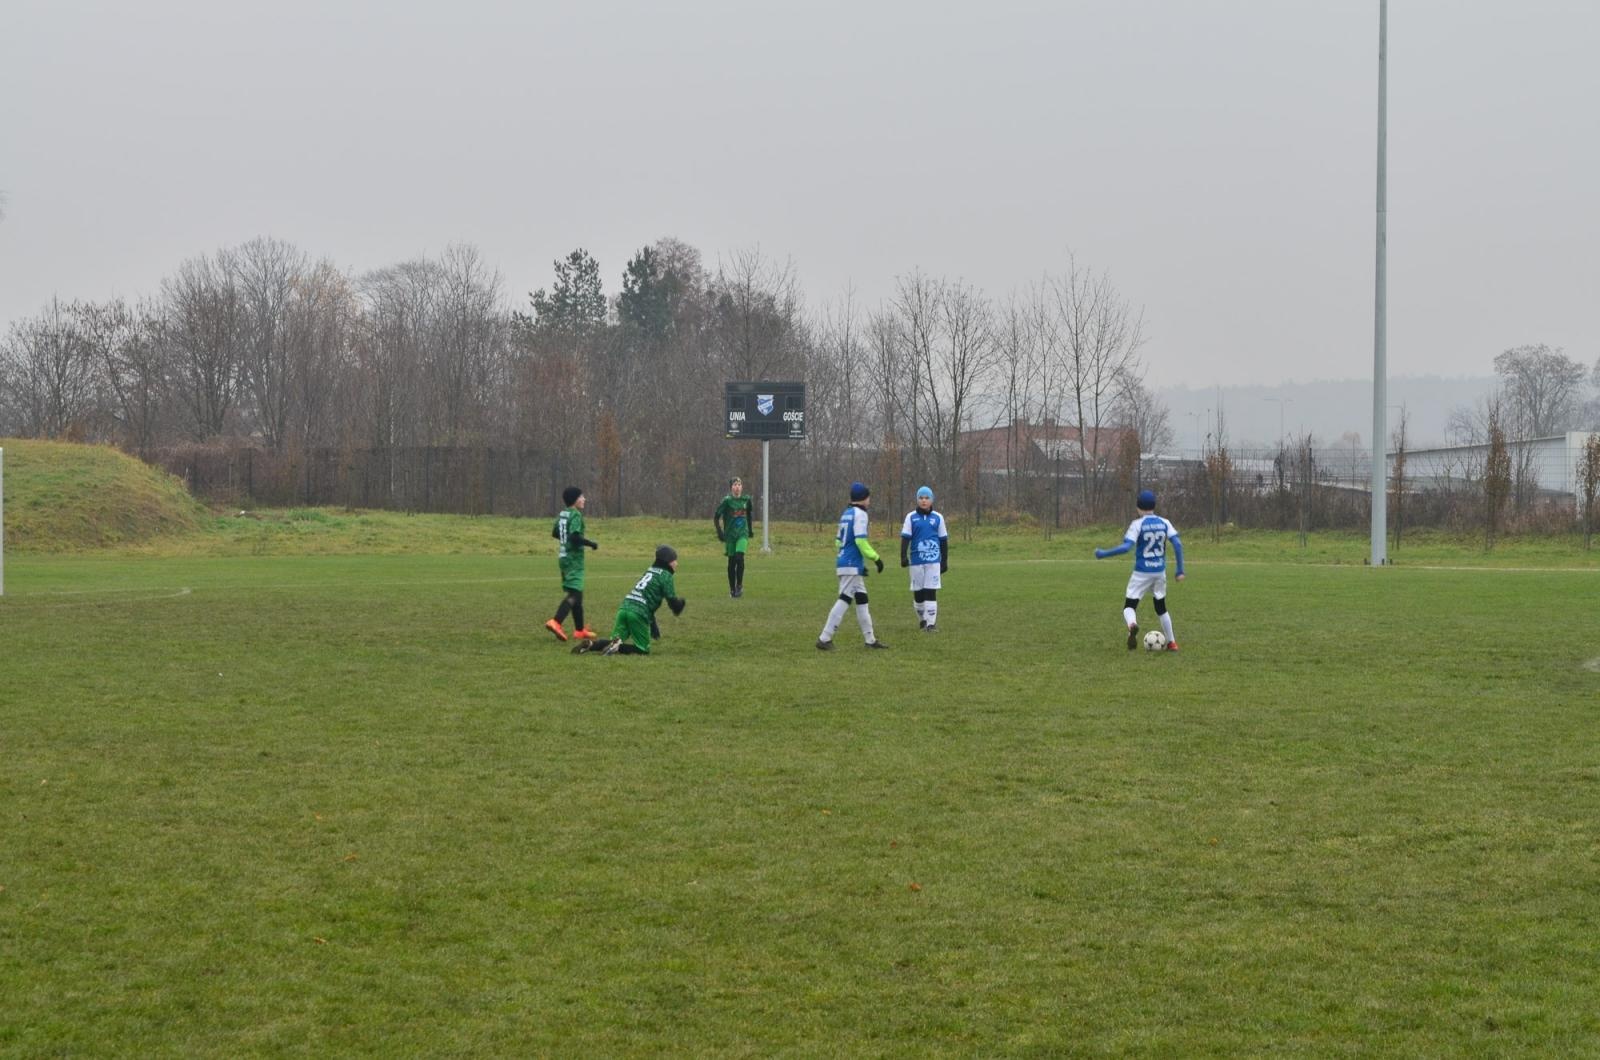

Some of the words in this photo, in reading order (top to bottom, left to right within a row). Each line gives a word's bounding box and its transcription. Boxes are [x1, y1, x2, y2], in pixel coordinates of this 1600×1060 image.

[729, 411, 746, 421] UNIA
[783, 410, 804, 421] GOŚCIE
[1143, 530, 1166, 558] 23
